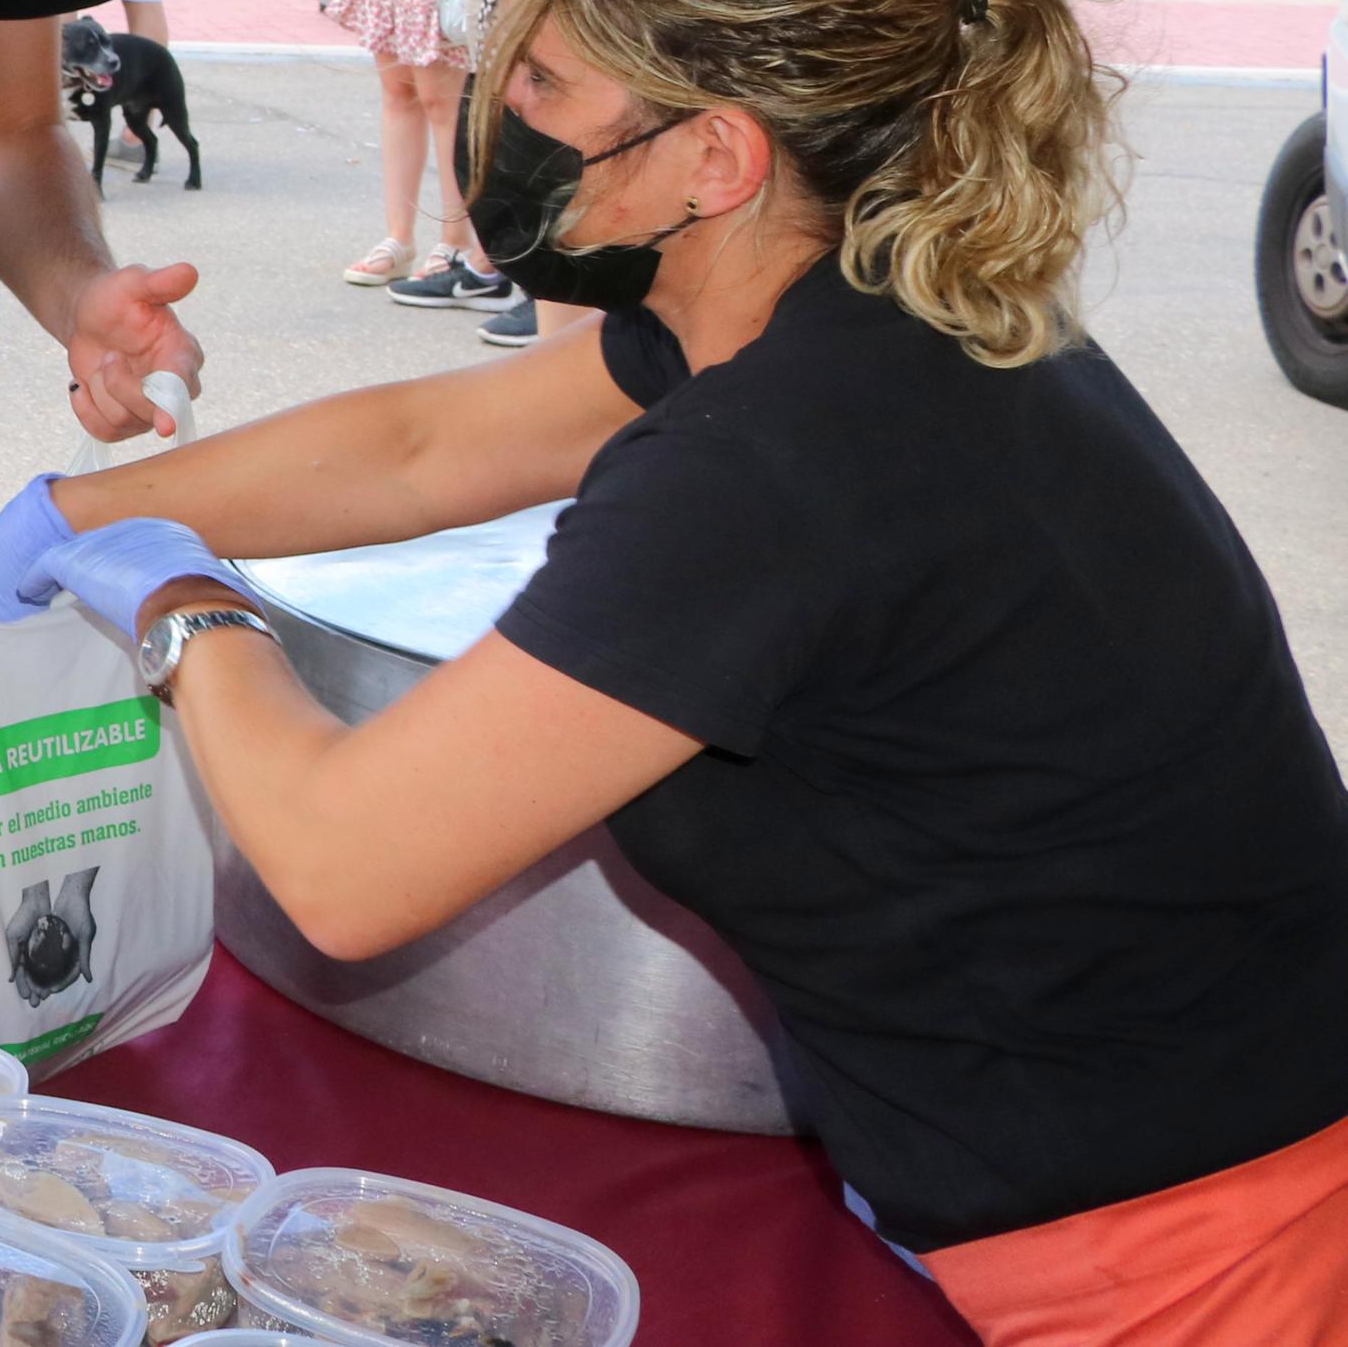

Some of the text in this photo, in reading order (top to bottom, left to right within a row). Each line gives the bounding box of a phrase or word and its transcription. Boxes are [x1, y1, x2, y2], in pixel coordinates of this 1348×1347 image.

[6, 718, 147, 770] REUTILIZABLE
[8, 812, 21, 834] el
[24, 799, 71, 829] medio
[77, 782, 153, 815] ambiente
[11, 833, 76, 866] nuestras
[80, 819, 142, 847] manos.
